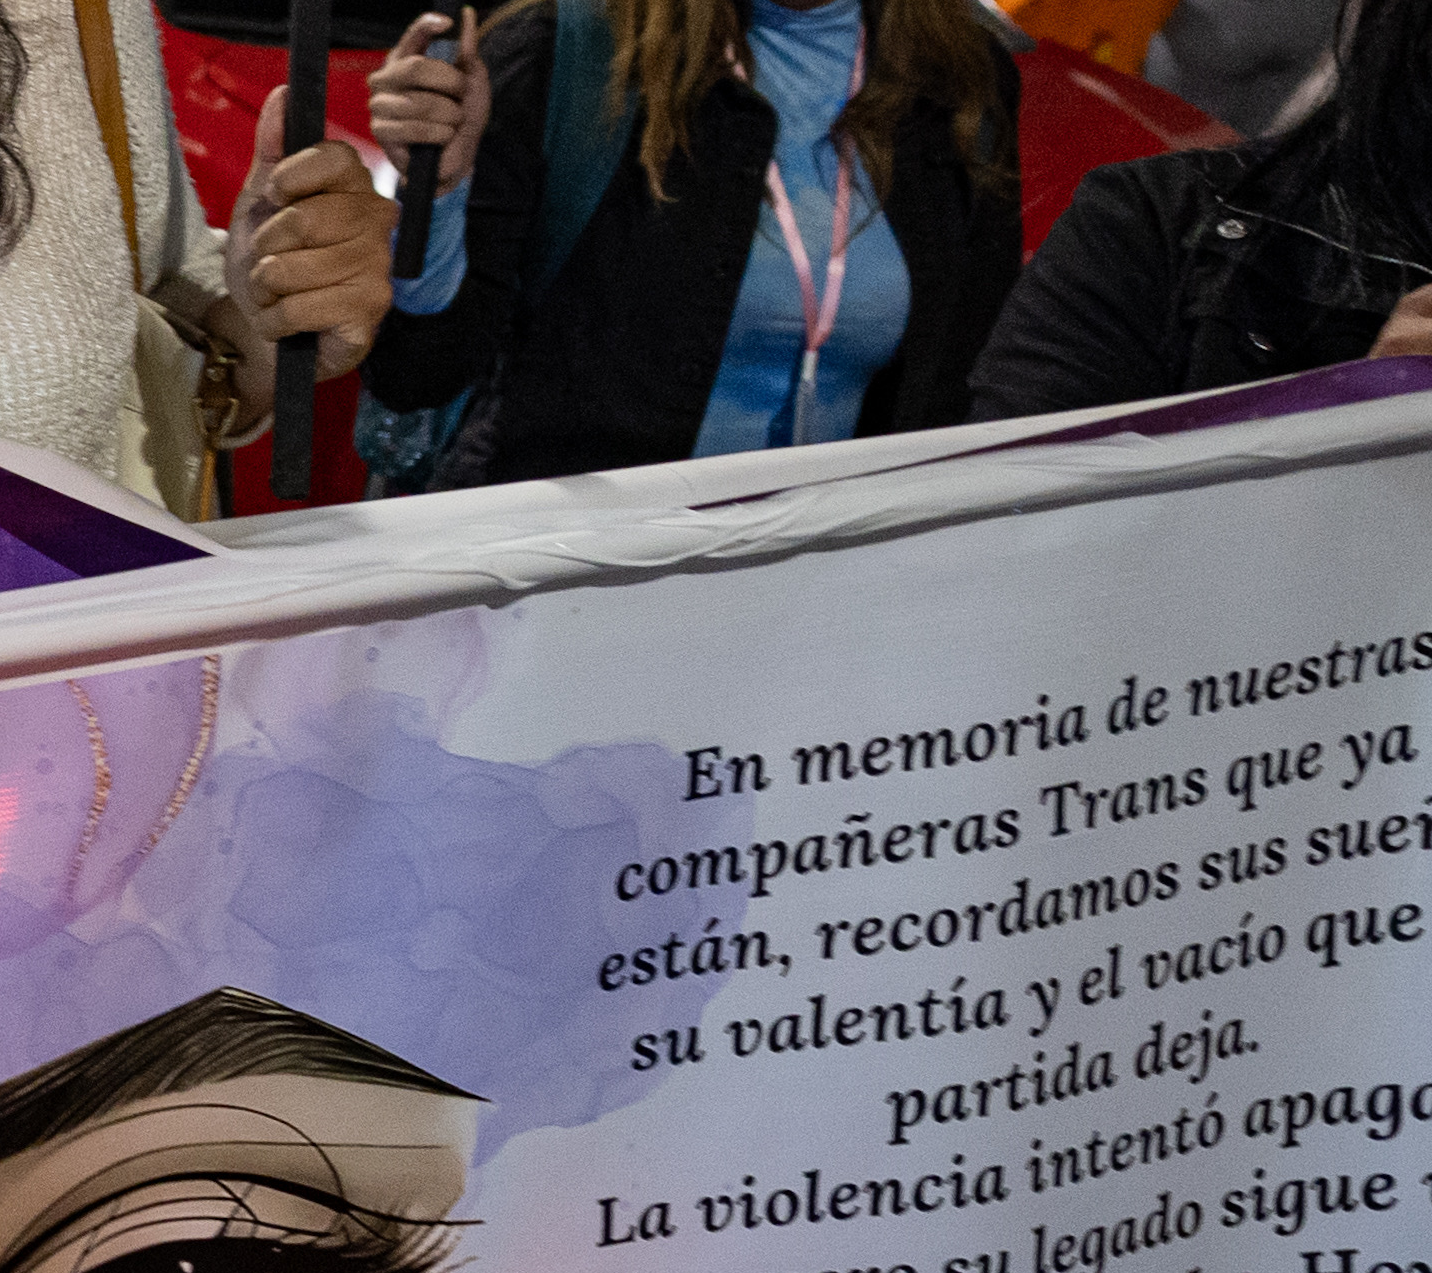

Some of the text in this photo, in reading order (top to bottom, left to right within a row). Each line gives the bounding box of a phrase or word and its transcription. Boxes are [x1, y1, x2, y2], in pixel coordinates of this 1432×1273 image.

[682, 631, 1432, 802] En memoria de nuestras
[615, 724, 1418, 902] compañeras Trans que ya
[597, 917, 792, 992] están,
[816, 861, 1180, 960] recordamos
[1198, 836, 1287, 891] sus
[630, 903, 1424, 1072] su valentía y el vacío que
[886, 1009, 1259, 1146] partida deja.
[596, 1196, 676, 1248] La
[696, 1153, 1008, 1233] violencia
[1028, 1091, 1225, 1194] intentó
[1220, 1168, 1398, 1237] sigue
